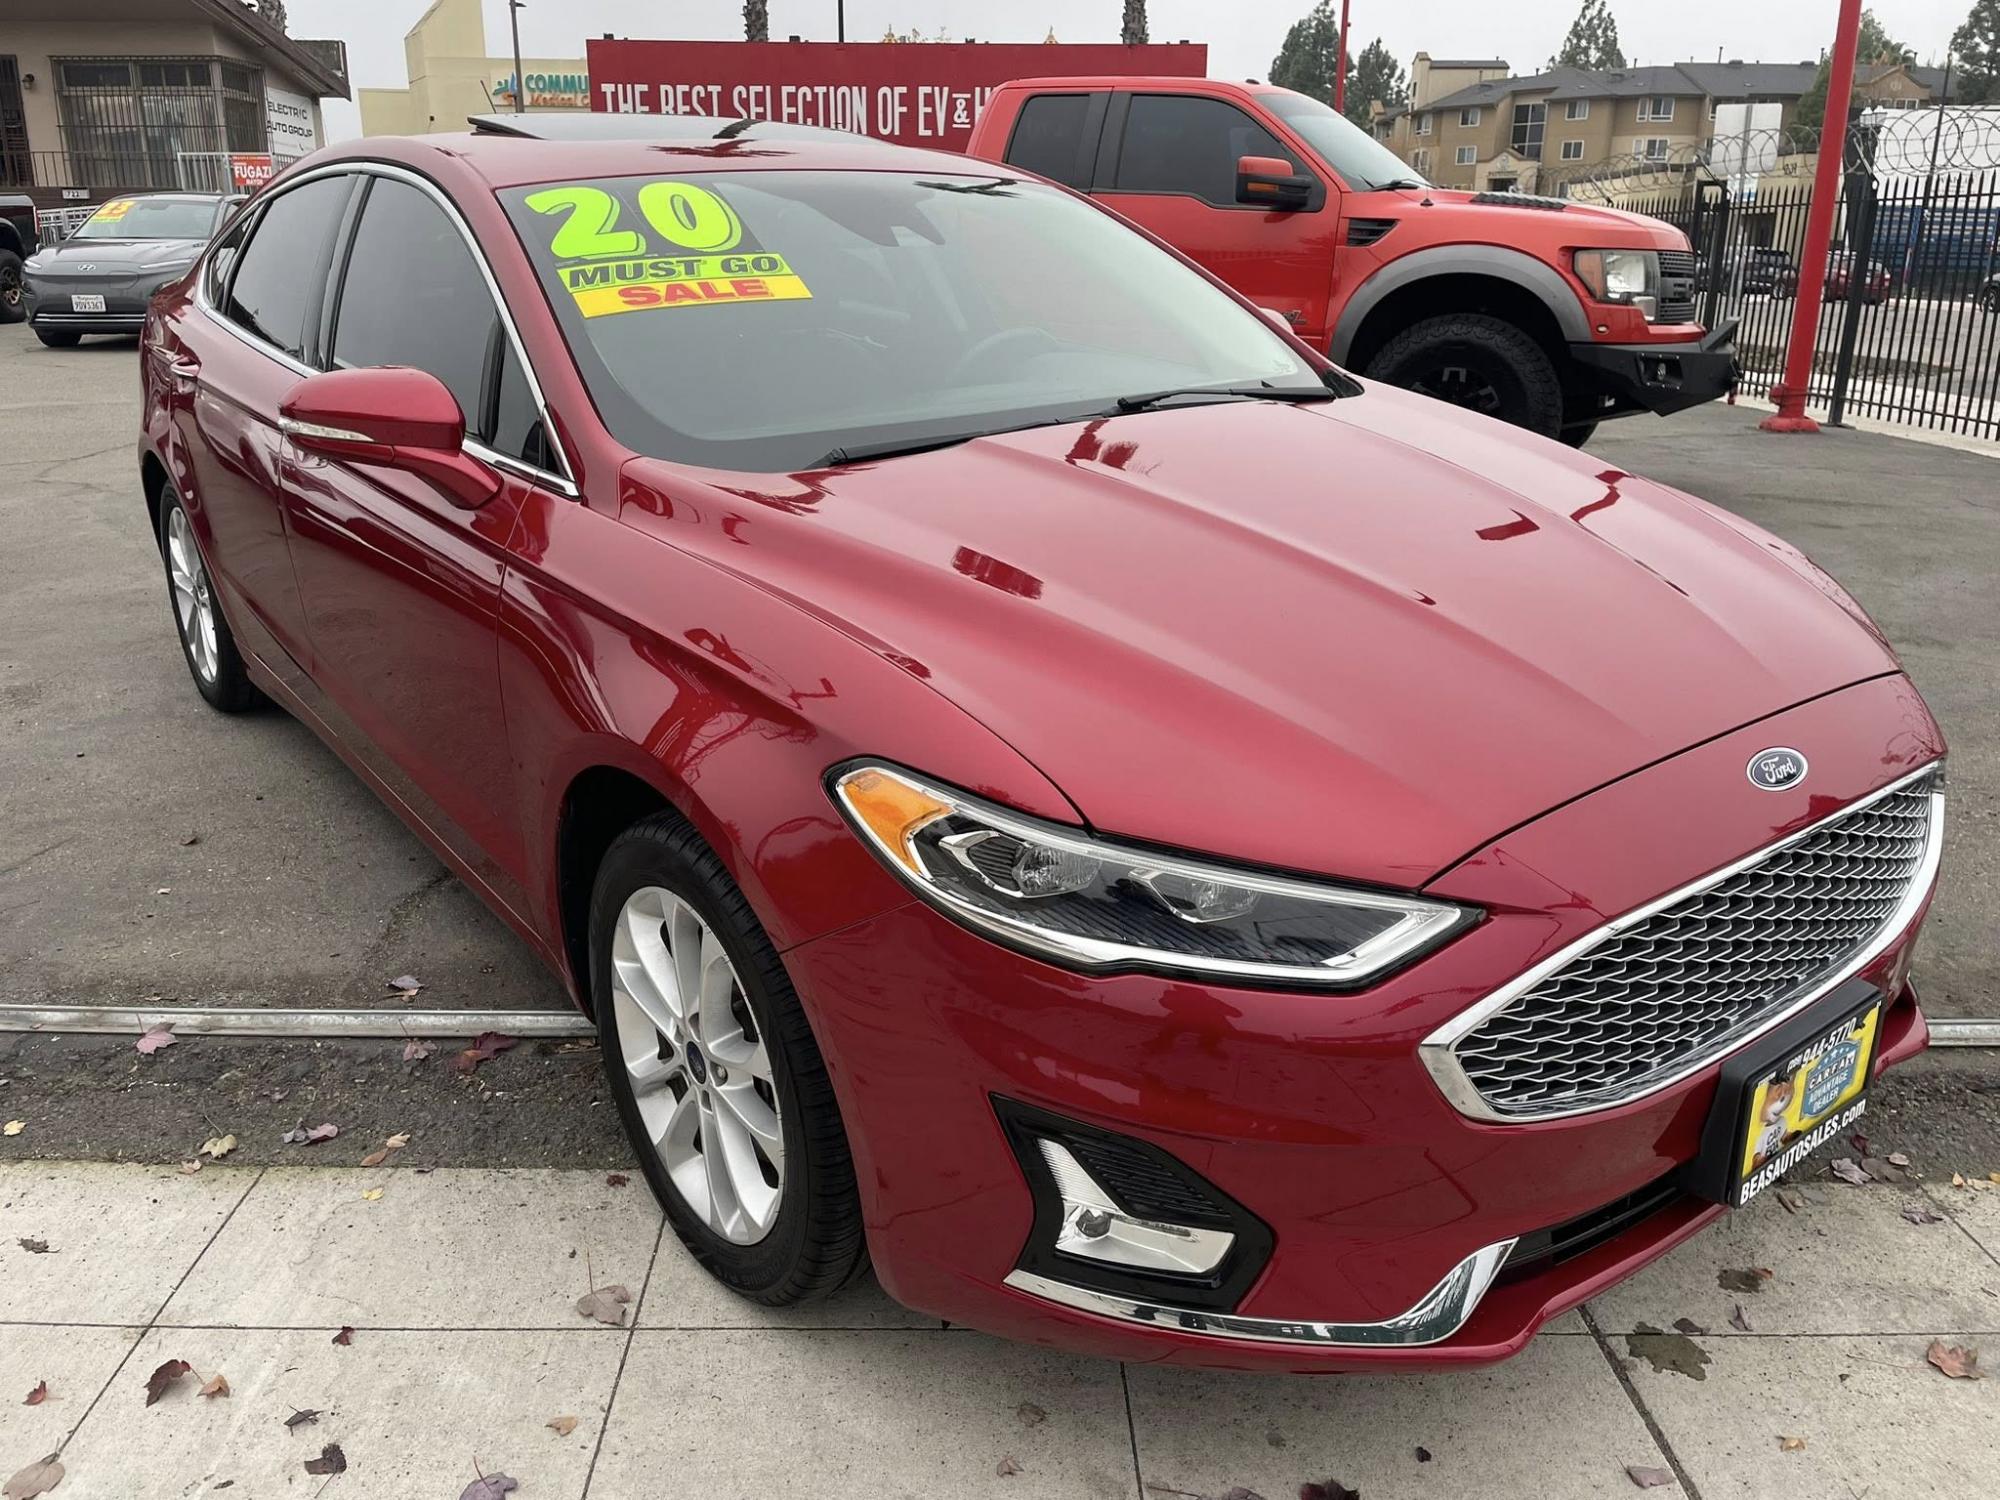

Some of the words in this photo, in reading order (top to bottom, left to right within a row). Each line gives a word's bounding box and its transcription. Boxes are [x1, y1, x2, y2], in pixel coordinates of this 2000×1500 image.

[267, 101, 308, 120] ELECTRIC
[601, 83, 650, 113] THE
[660, 84, 722, 117] BEST
[732, 85, 867, 135] SELECTION
[877, 86, 908, 136] OF
[918, 86, 950, 137] EV
[953, 97, 971, 125] &
[266, 120, 288, 133] AUTO
[288, 124, 313, 138] GROUP
[234, 165, 272, 178] FUGAZI
[569, 259, 705, 289] MUST
[721, 256, 785, 275] GO
[618, 279, 773, 306] SALE
[1760, 756, 1797, 784] Ford
[1808, 1069, 1849, 1105] ADVANTAGE
[1812, 1086, 1840, 1113] DEALER
[1739, 1098, 1867, 1206] BEASAUTOSALES.com
